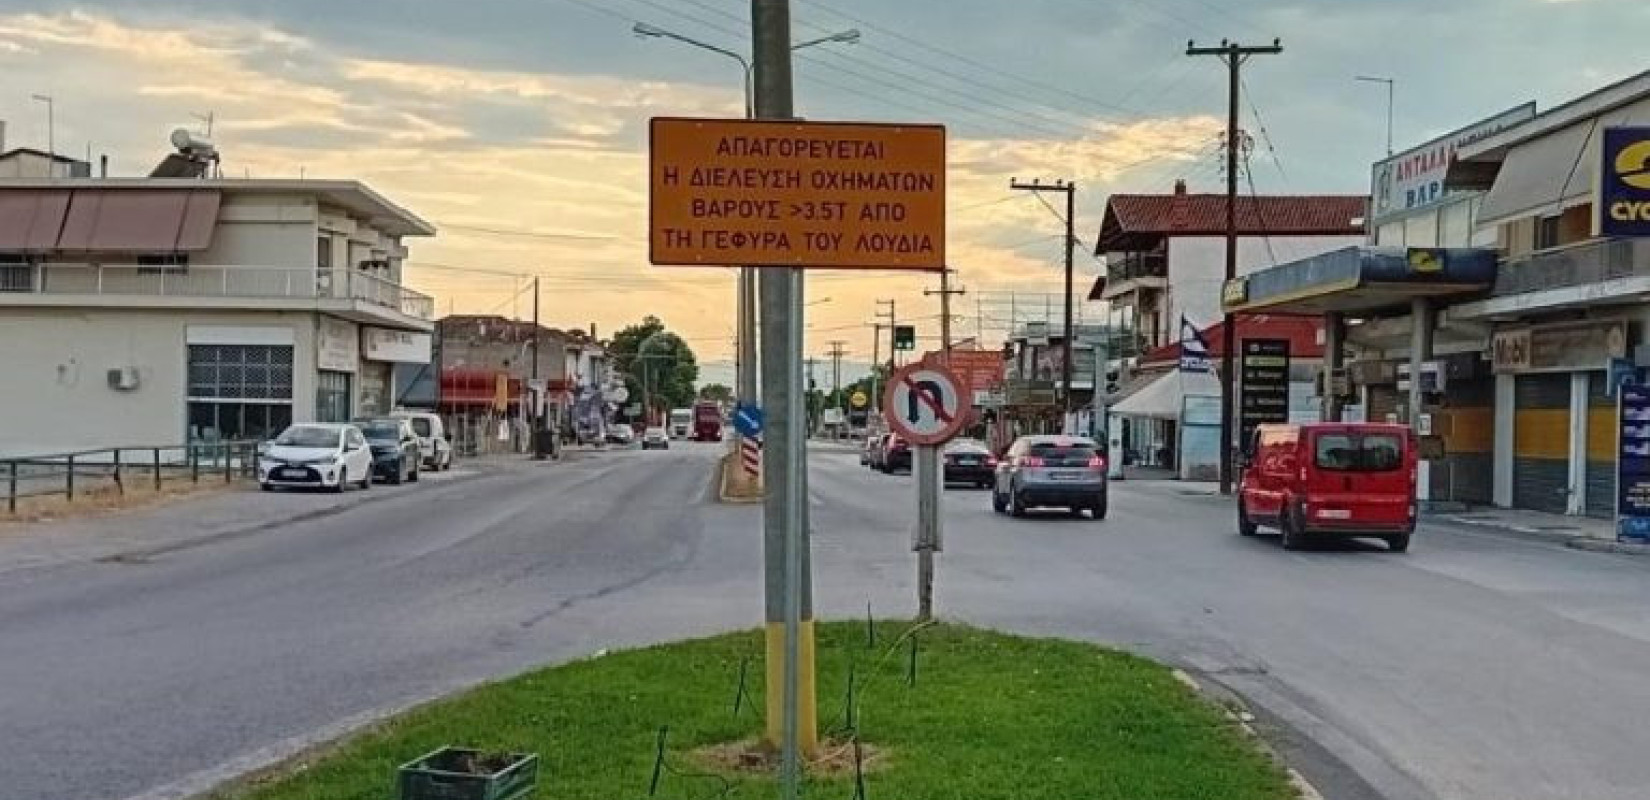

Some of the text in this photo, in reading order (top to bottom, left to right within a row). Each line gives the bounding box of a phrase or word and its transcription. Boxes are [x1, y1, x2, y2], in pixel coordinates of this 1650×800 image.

[717, 136, 884, 160] ΑΠΑΓΟΡΕΥΕΤΑΙ
[663, 166, 934, 192] Η ΔΙΕΛΕΥΣΗ ΟΧΗΜΑΤΩΝ
[1406, 180, 1446, 207] ΒΑΡ
[692, 198, 906, 223] ΒΑΡΟΥΣ >3.5Τ ΑΠΟ
[663, 228, 934, 254] ΤΗ ΓΕΦΥΡΑ ΤΟΥ ΛΟΥΔΙΑ
